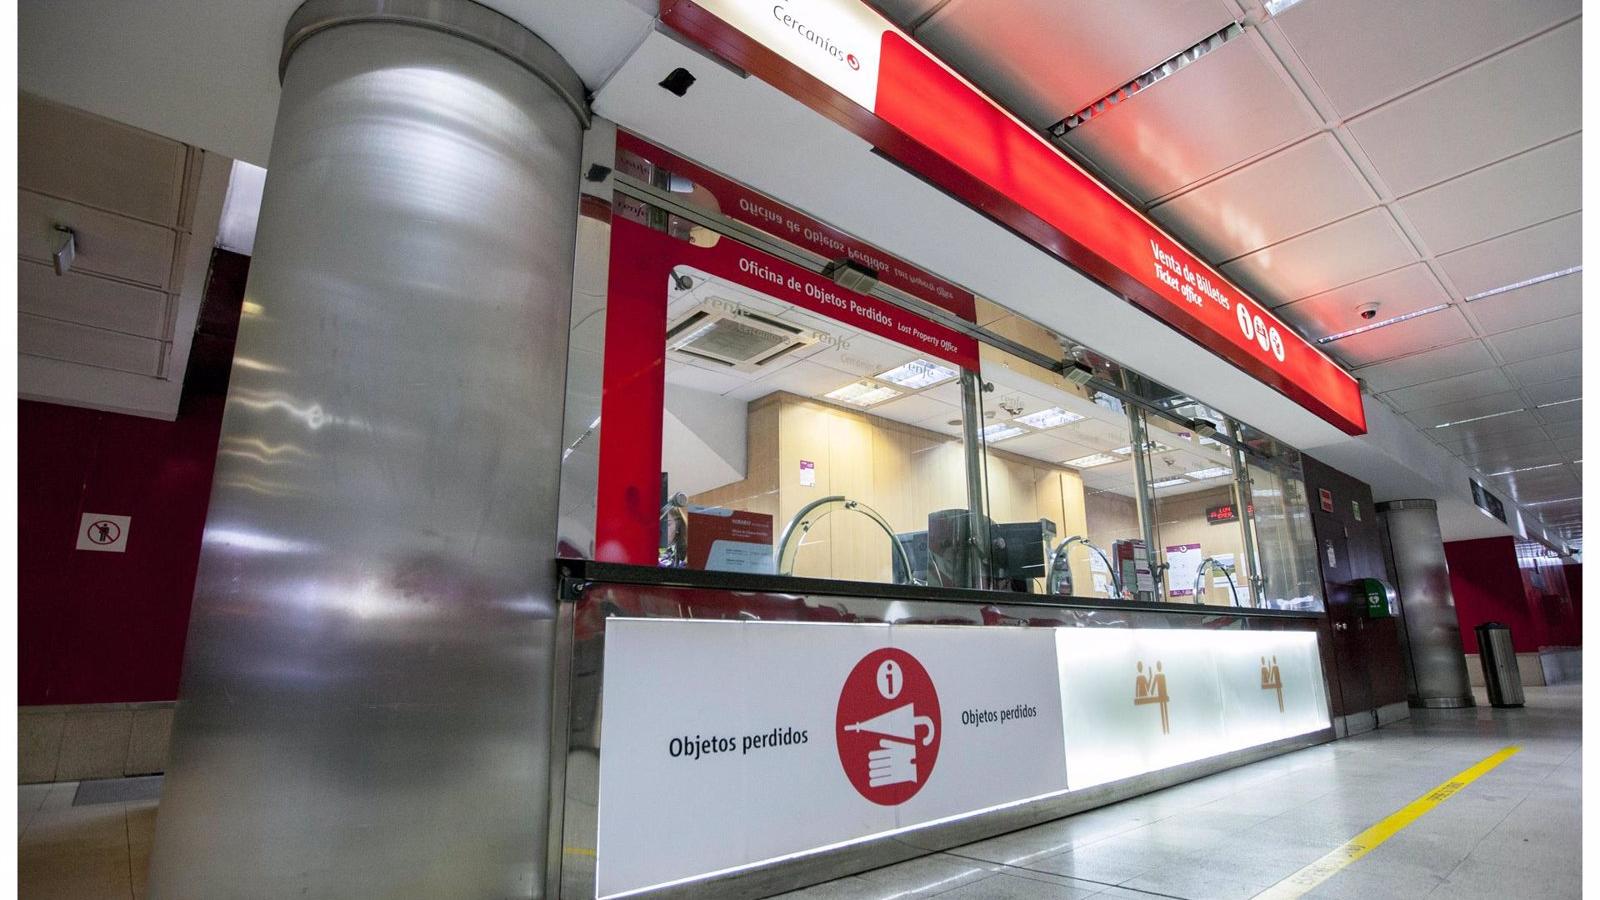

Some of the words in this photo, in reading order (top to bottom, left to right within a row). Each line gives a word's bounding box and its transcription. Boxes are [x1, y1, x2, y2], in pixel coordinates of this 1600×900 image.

[773, 5, 844, 62] Cercanías
[1150, 239, 1182, 276] Venta
[1183, 263, 1196, 286] de
[1196, 272, 1230, 311] Billetes
[1154, 262, 1180, 292] Ticket
[1181, 282, 1203, 308] office
[739, 258, 784, 286] Oficina
[787, 276, 802, 293] de
[805, 282, 848, 311] Objetos
[850, 299, 894, 328] Perdidos
[898, 322, 912, 336] Lost
[912, 328, 940, 348] Property
[940, 339, 959, 354] Office
[812, 331, 850, 351] renfe
[961, 709, 998, 728] Objetos
[1000, 704, 1038, 724] perdidos
[669, 734, 736, 761] Objetos
[742, 727, 809, 755] perdidos
